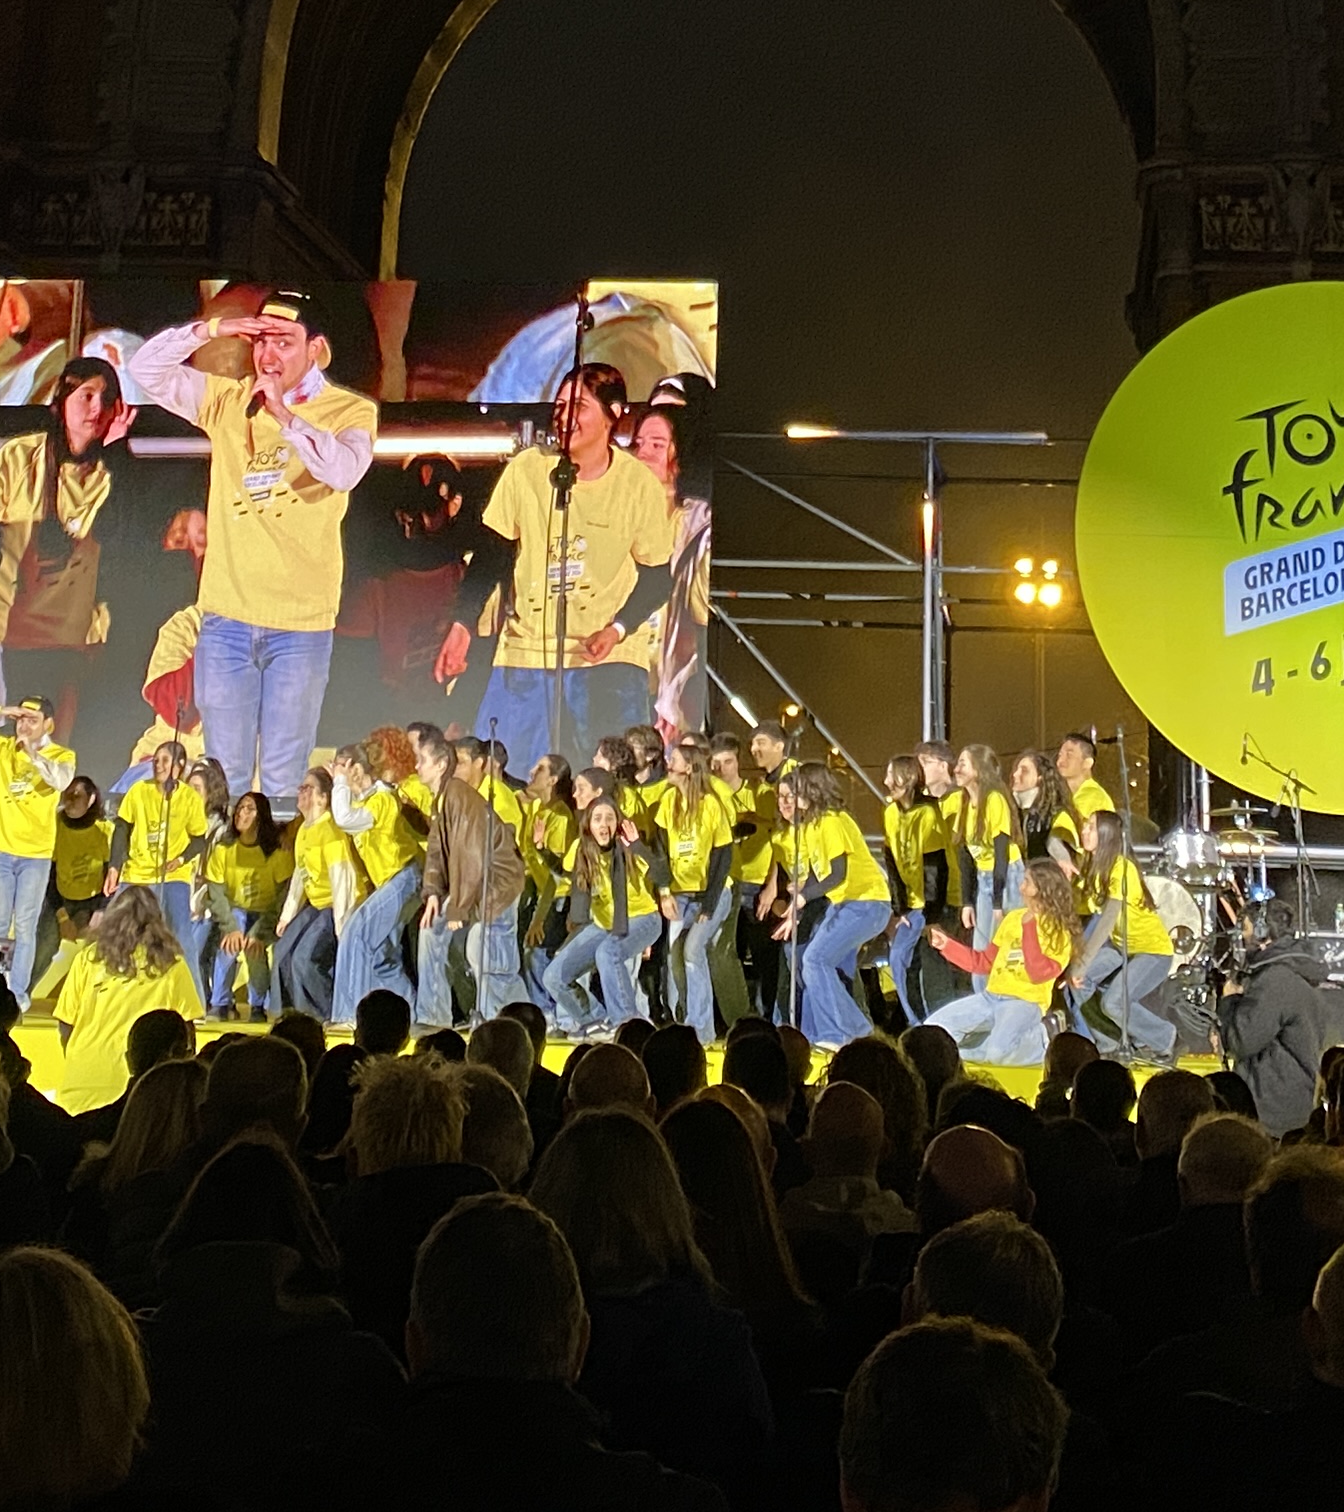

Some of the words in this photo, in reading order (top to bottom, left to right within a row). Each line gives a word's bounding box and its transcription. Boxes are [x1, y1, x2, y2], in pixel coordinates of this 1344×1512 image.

[1244, 546, 1326, 590] GRAND
[1251, 656, 1276, 697] 4
[1310, 640, 1332, 682] 6
